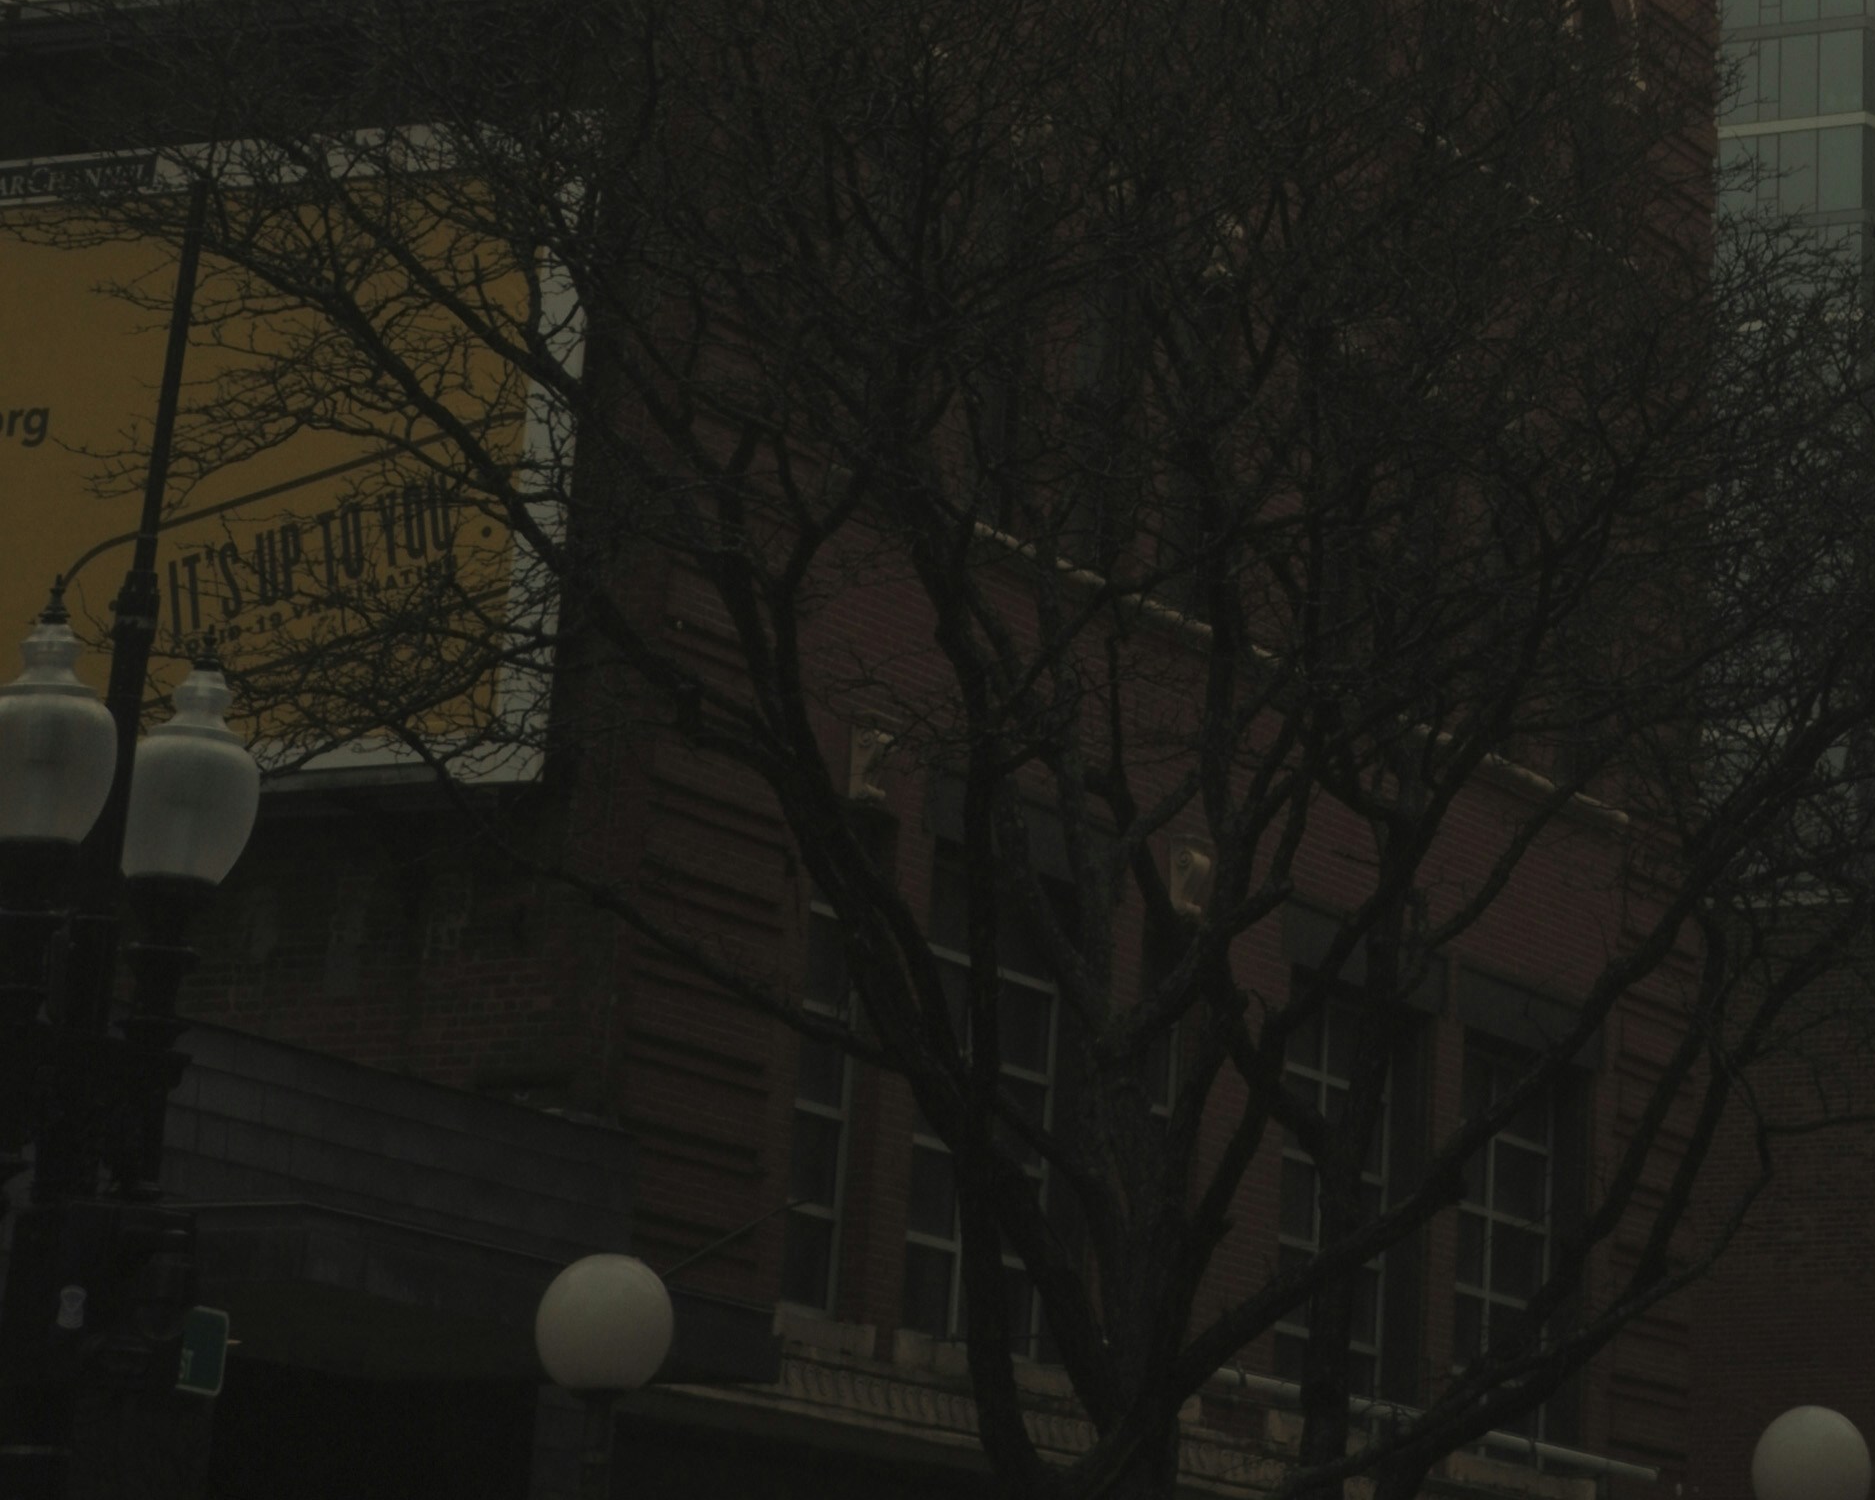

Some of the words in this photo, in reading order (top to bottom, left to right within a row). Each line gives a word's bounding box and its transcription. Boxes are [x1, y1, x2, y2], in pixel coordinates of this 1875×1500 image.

[0, 406, 50, 449] rg
[168, 541, 242, 638] IT'S
[255, 522, 302, 607] UP
[317, 501, 365, 589] TO
[377, 474, 452, 568] YOU
[168, 608, 282, 652] COID-19
